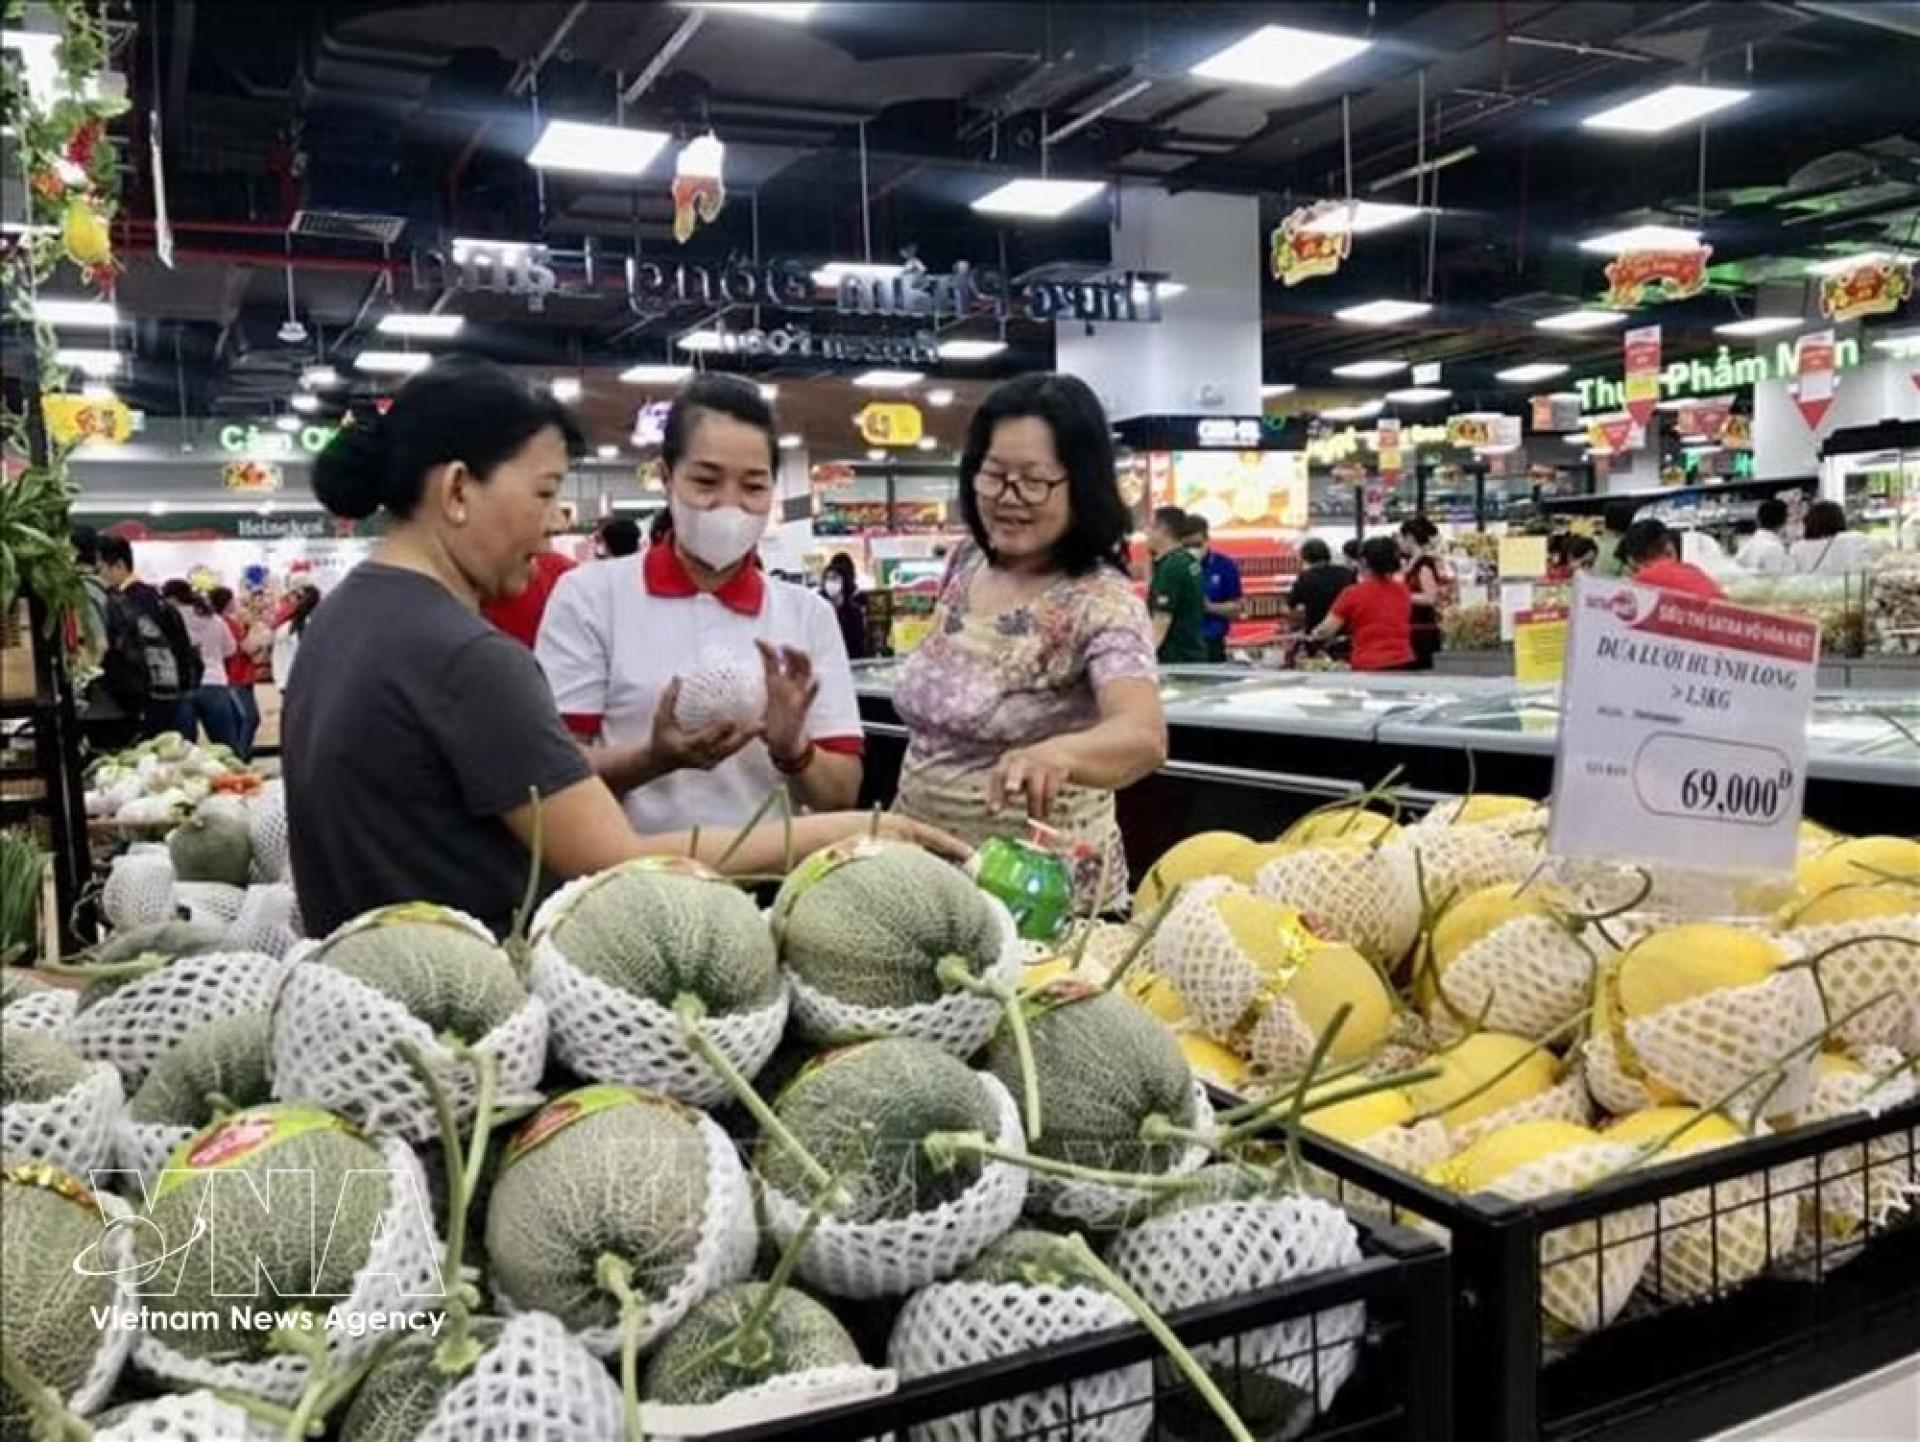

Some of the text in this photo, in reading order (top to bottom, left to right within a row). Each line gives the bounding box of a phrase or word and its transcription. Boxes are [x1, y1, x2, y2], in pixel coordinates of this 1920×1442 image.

[1668, 345, 1767, 395] Phẩm
[1777, 337, 1859, 378] Mn
[237, 518, 324, 536] Heineken
[1750, 663, 1799, 691] LONG
